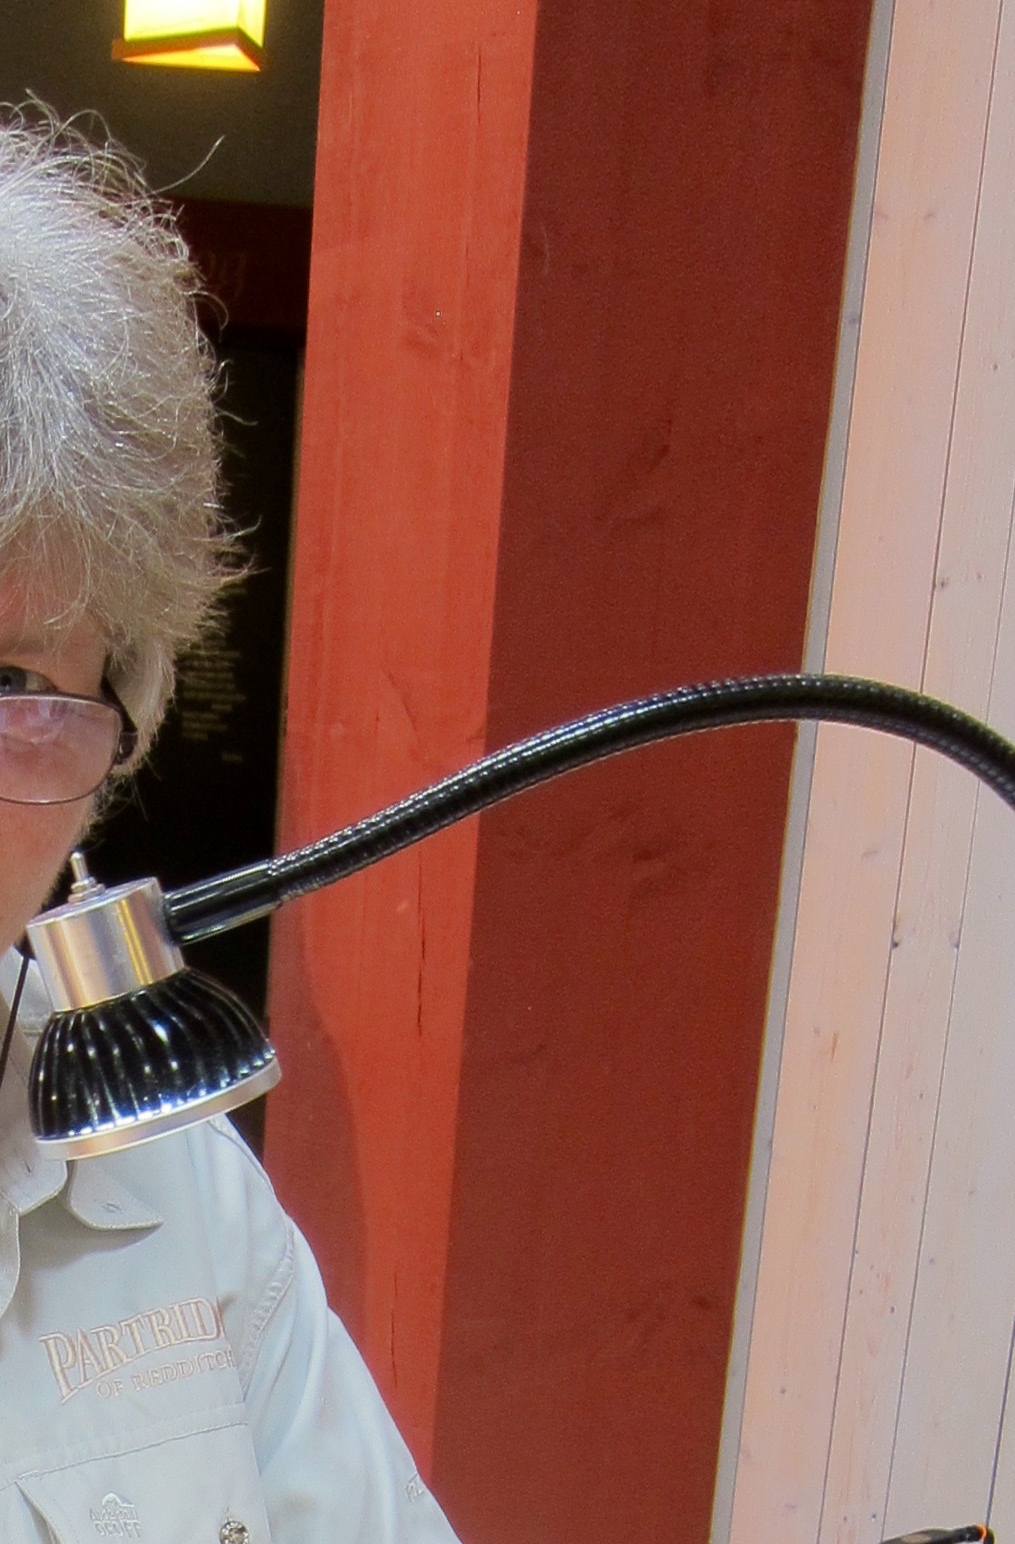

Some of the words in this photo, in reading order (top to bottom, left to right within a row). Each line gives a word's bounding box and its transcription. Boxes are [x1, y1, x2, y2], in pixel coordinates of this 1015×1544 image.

[38, 1297, 226, 1405] PARTRID
[96, 1380, 125, 1400] OF
[133, 1348, 236, 1391] REDDITCH
